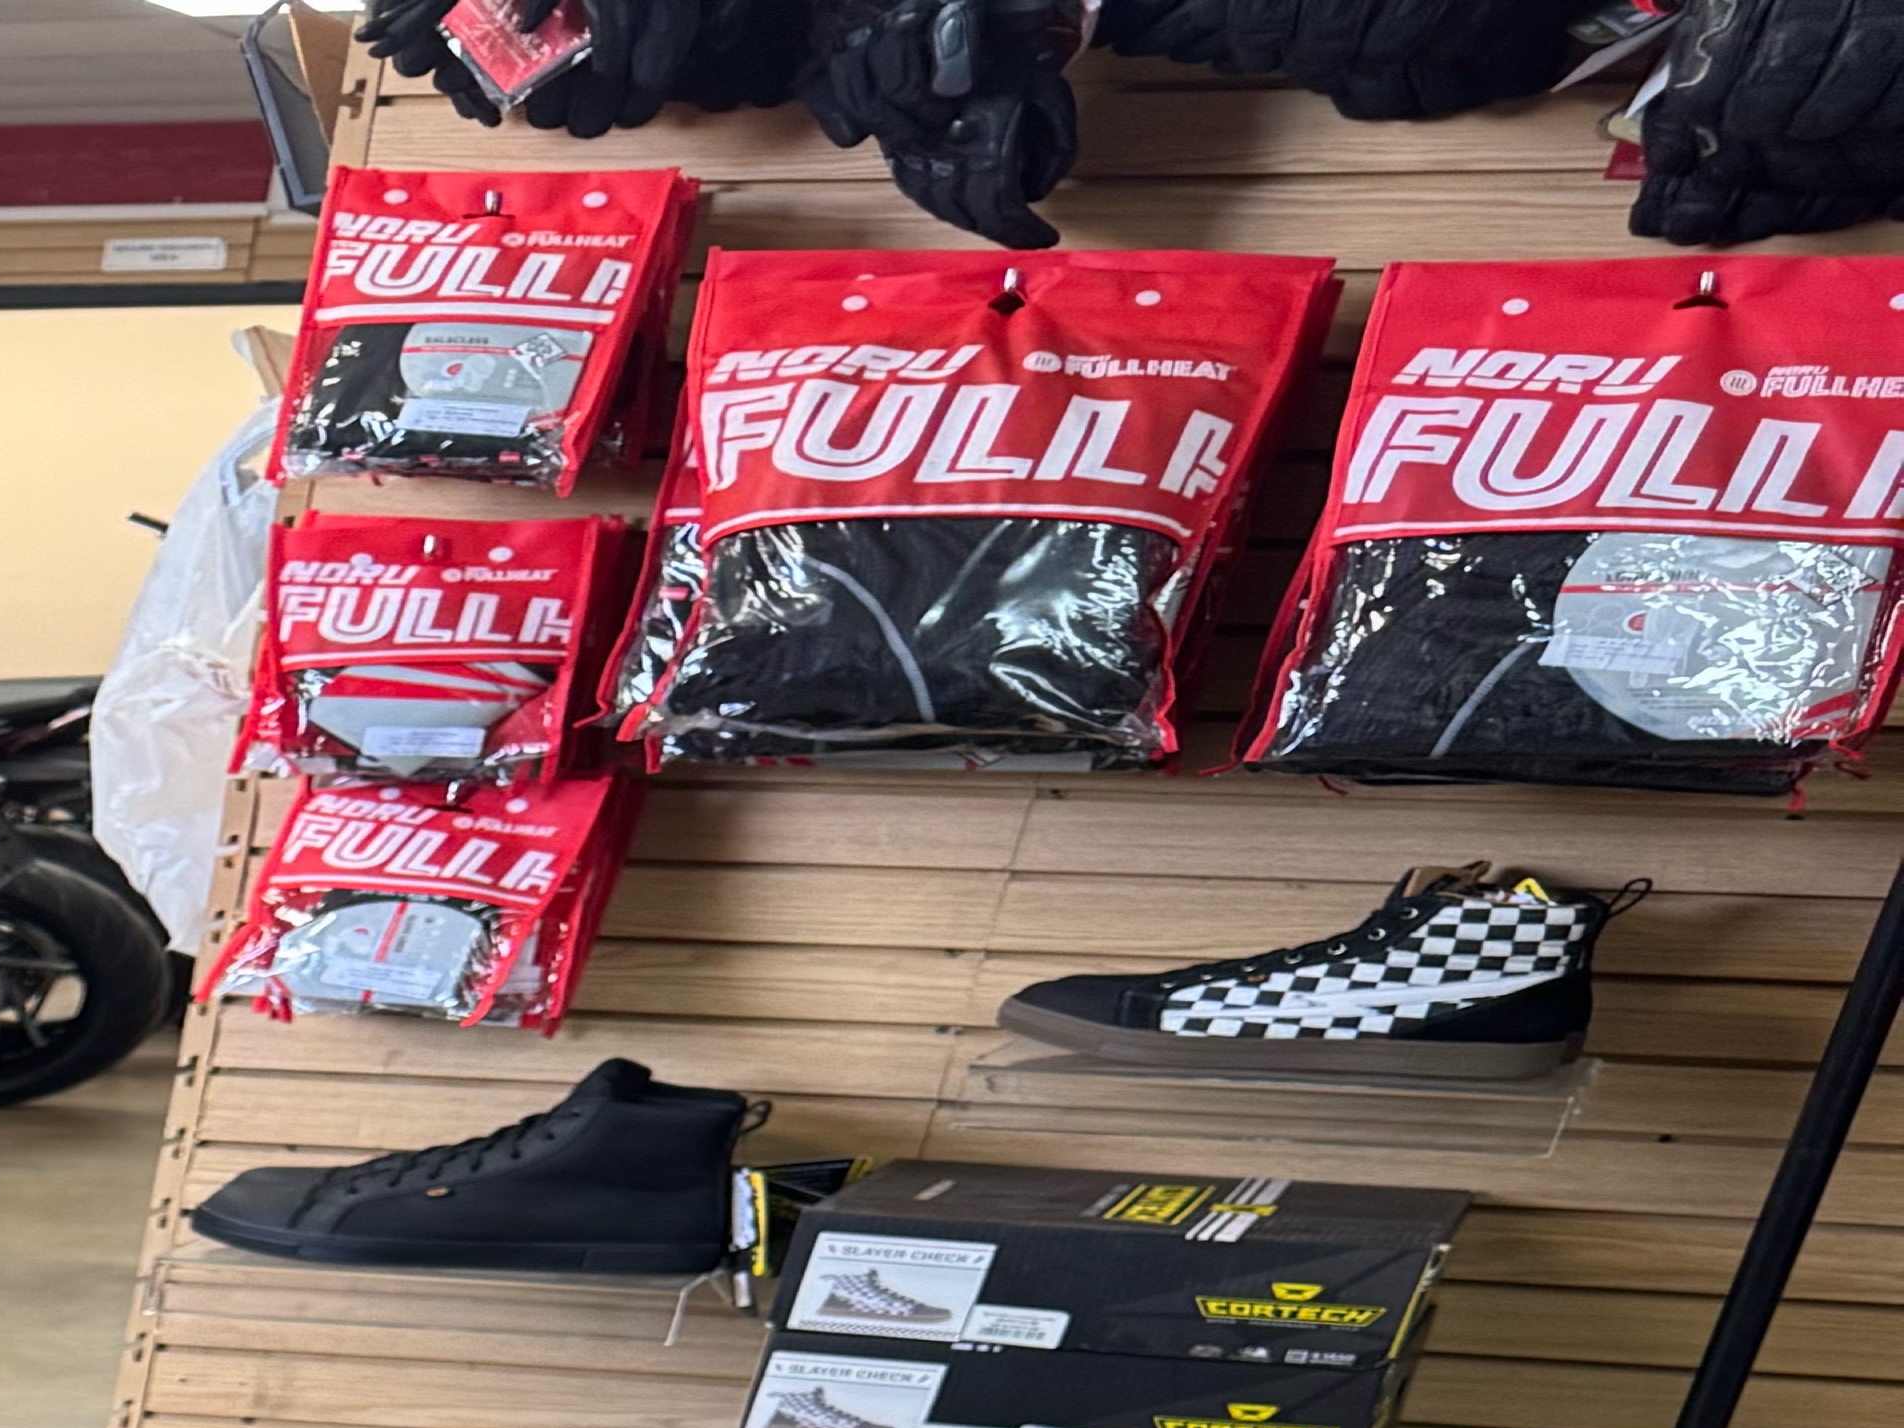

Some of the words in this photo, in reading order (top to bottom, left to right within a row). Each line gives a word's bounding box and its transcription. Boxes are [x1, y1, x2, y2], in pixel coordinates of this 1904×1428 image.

[331, 212, 483, 243] NORU
[707, 344, 985, 382] NORU
[1065, 354, 1238, 380] FULLHEAT
[1391, 348, 1682, 395] NORU
[1760, 376, 1904, 399] FULLHE
[280, 560, 421, 585] NORU
[305, 794, 441, 825] NORU
[842, 1245, 905, 1260] SLAYER
[910, 1250, 972, 1264] CHECK
[1205, 1301, 1374, 1324] CORTECH
[858, 1369, 914, 1383] CHECK
